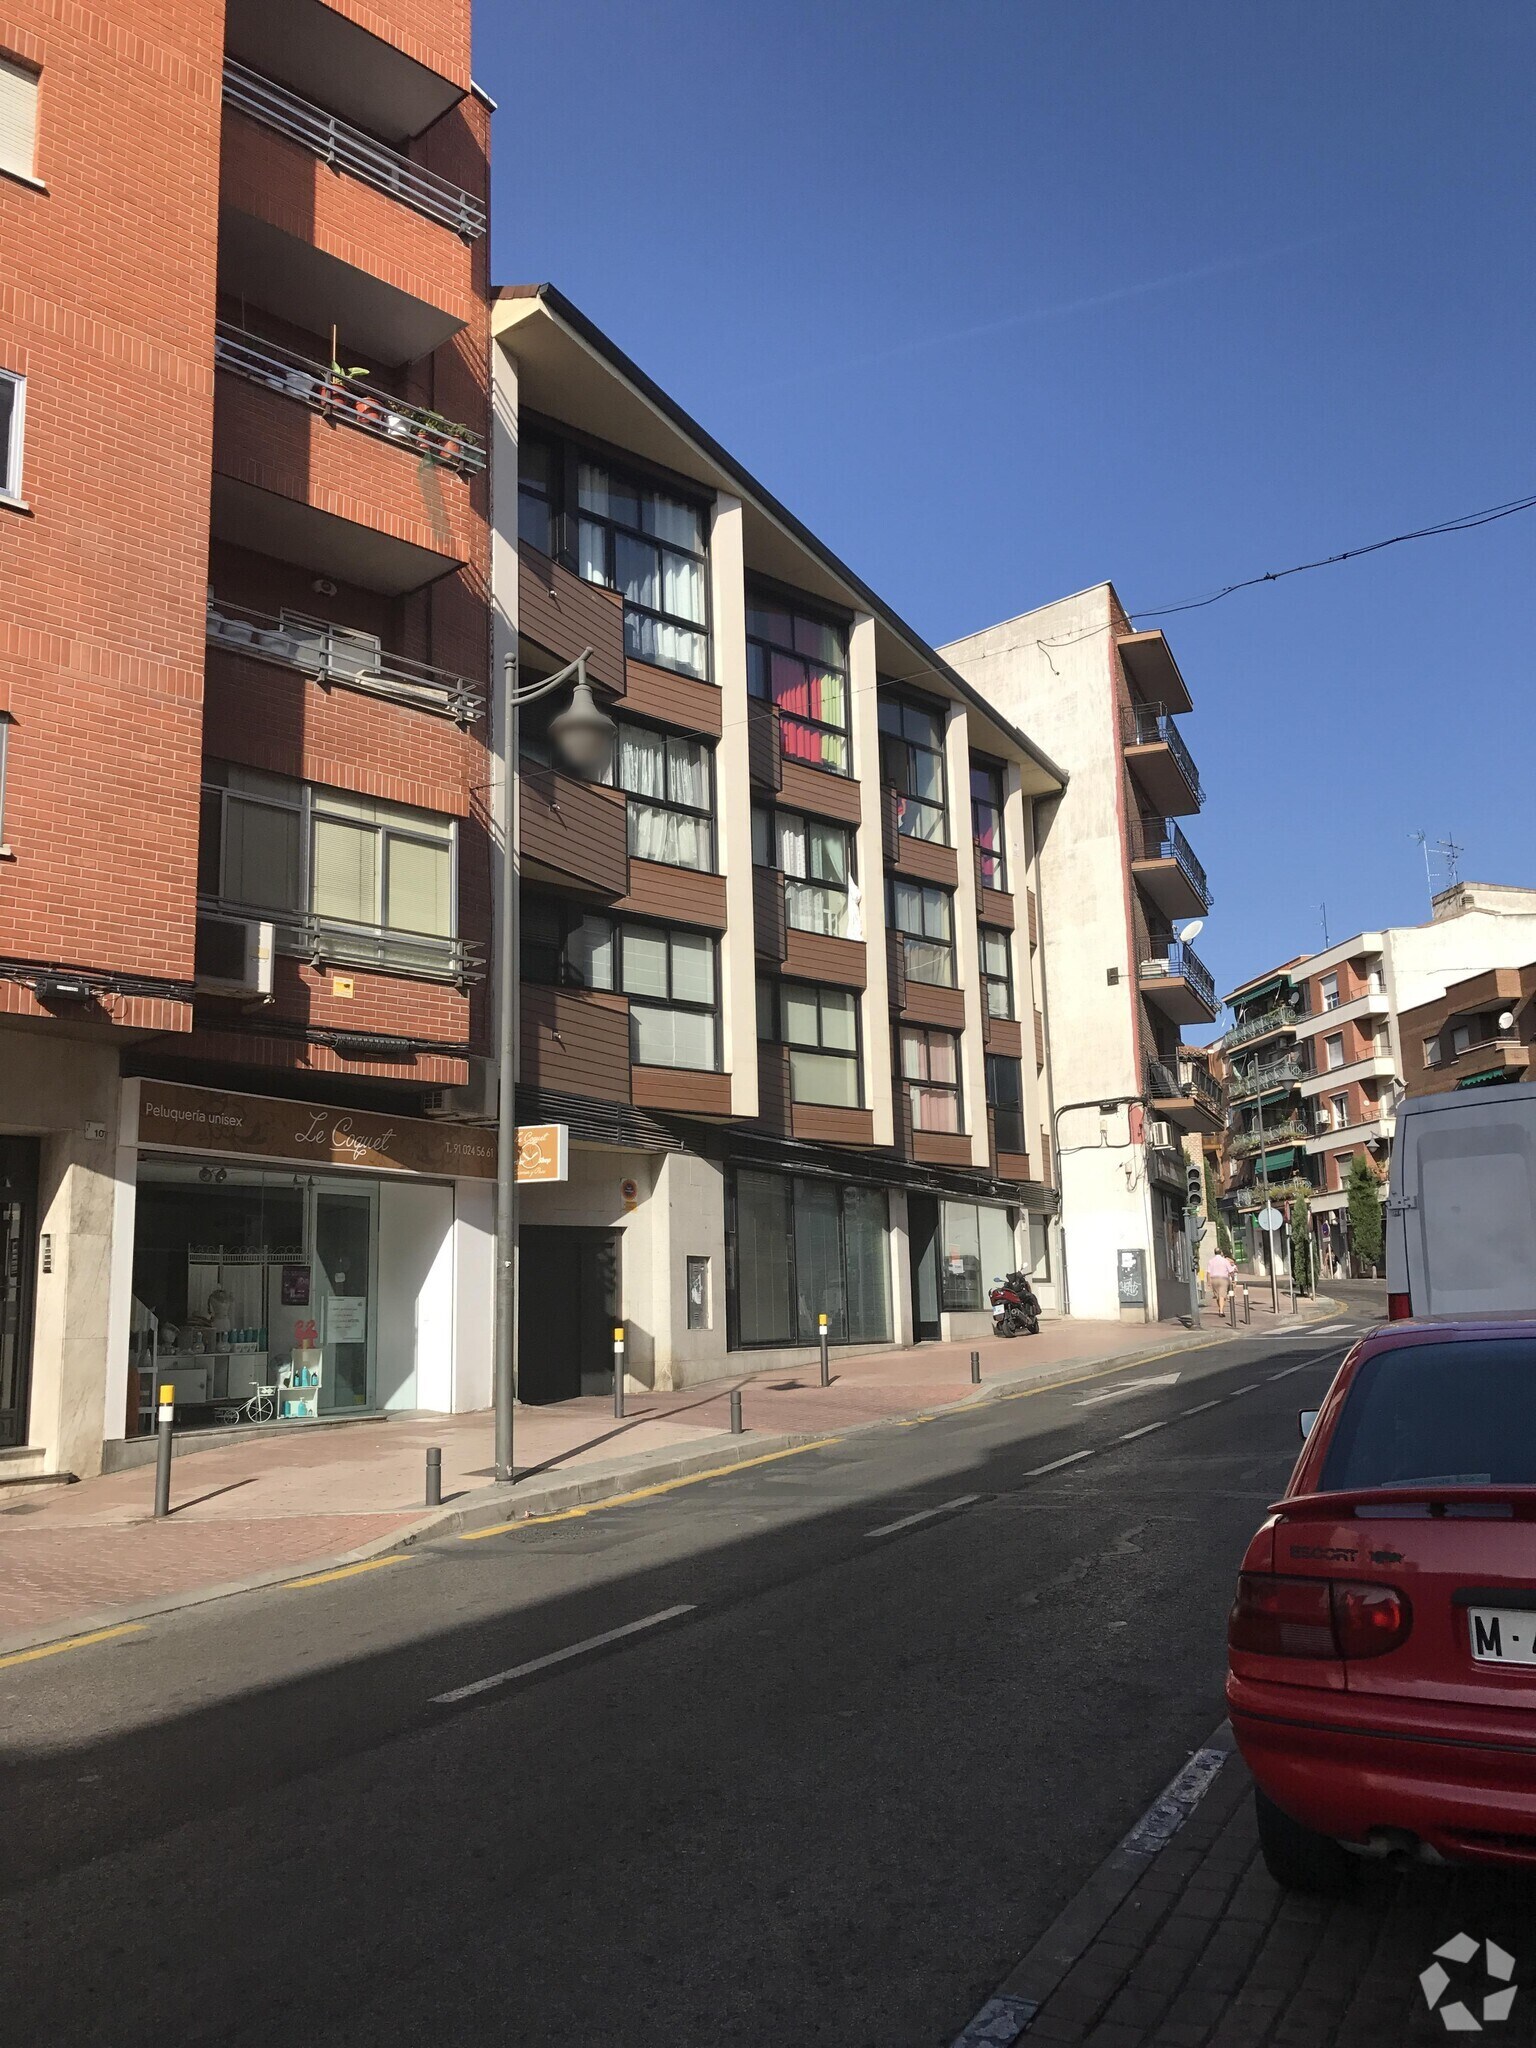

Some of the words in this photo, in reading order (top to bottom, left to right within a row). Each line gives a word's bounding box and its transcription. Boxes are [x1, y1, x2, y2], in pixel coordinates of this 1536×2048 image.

[295, 1112, 327, 1143] Le
[330, 1117, 397, 1160] Coquet
[453, 1143, 461, 1154] 91
[462, 1144, 476, 1156] 024
